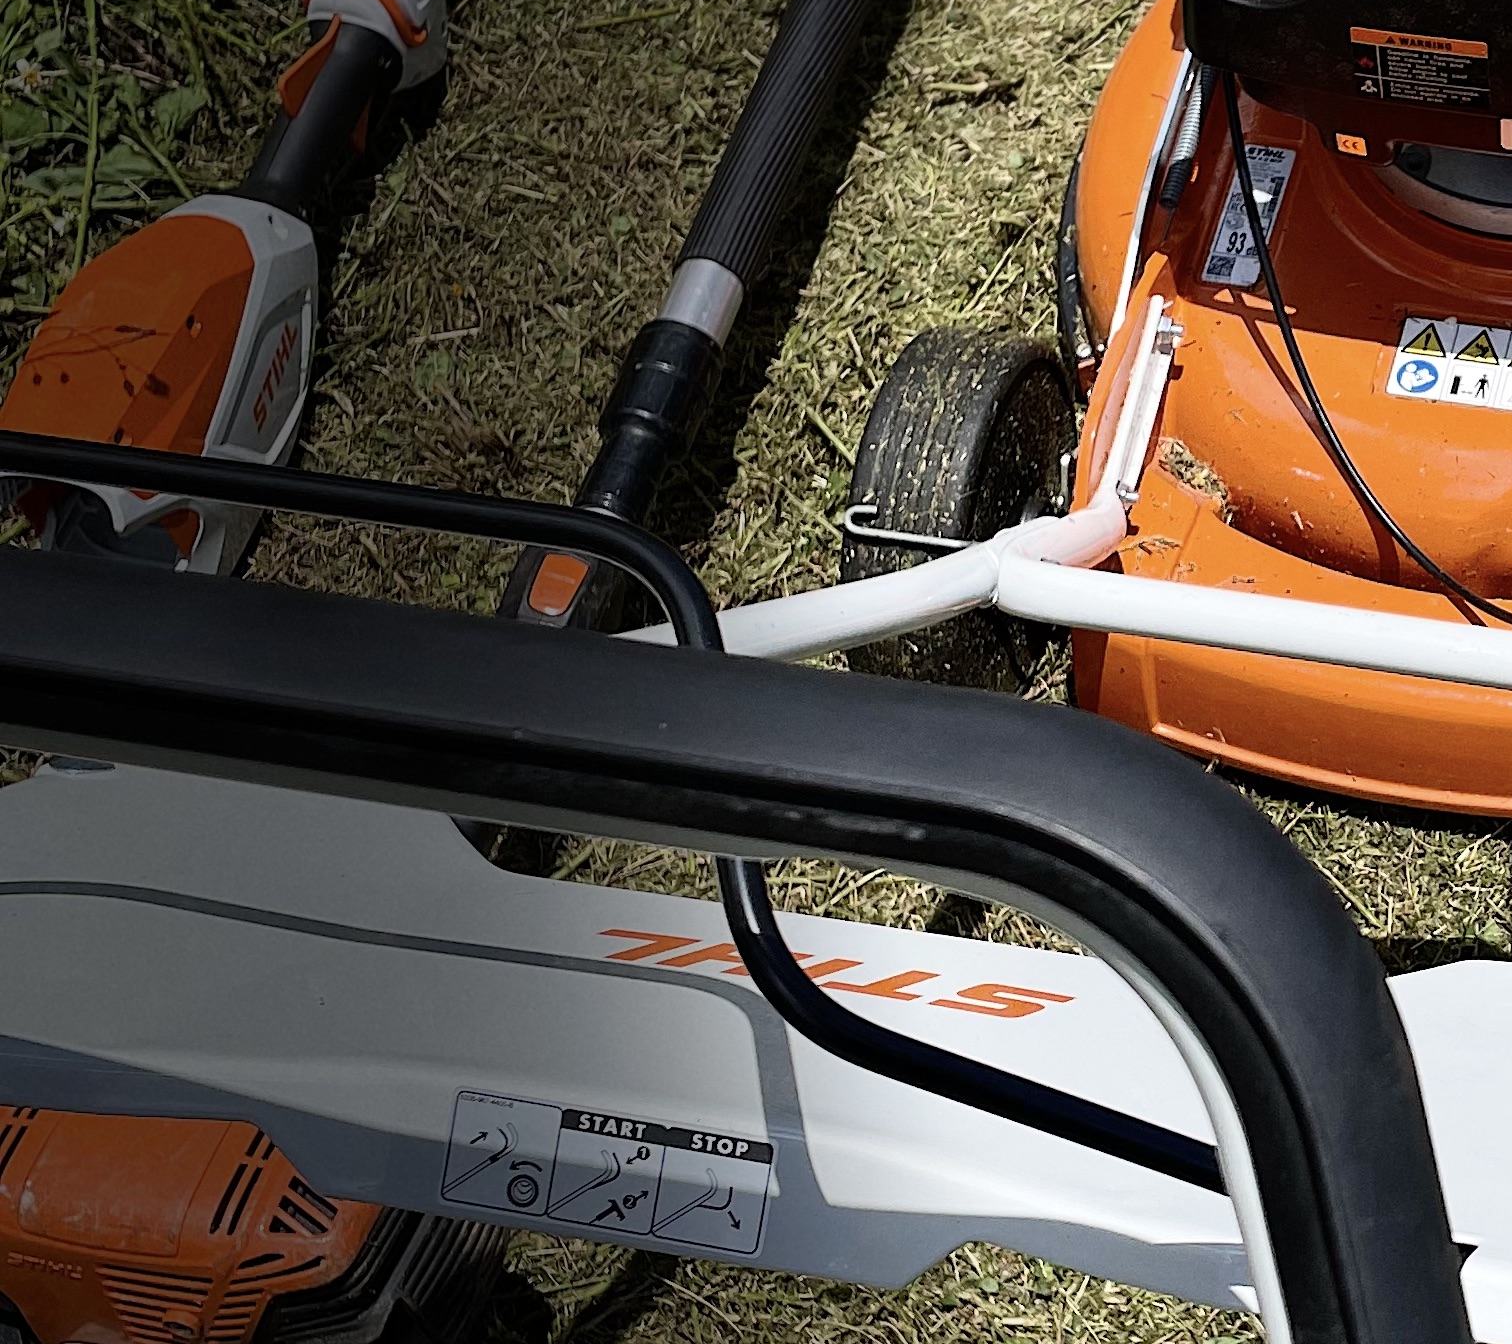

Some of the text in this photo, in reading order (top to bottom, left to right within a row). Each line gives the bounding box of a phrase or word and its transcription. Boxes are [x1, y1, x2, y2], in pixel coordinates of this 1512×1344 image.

[1398, 37, 1453, 52] WARNING
[1226, 231, 1247, 255] 93
[253, 319, 299, 434] STIHL
[577, 1112, 749, 1157] START STOP
